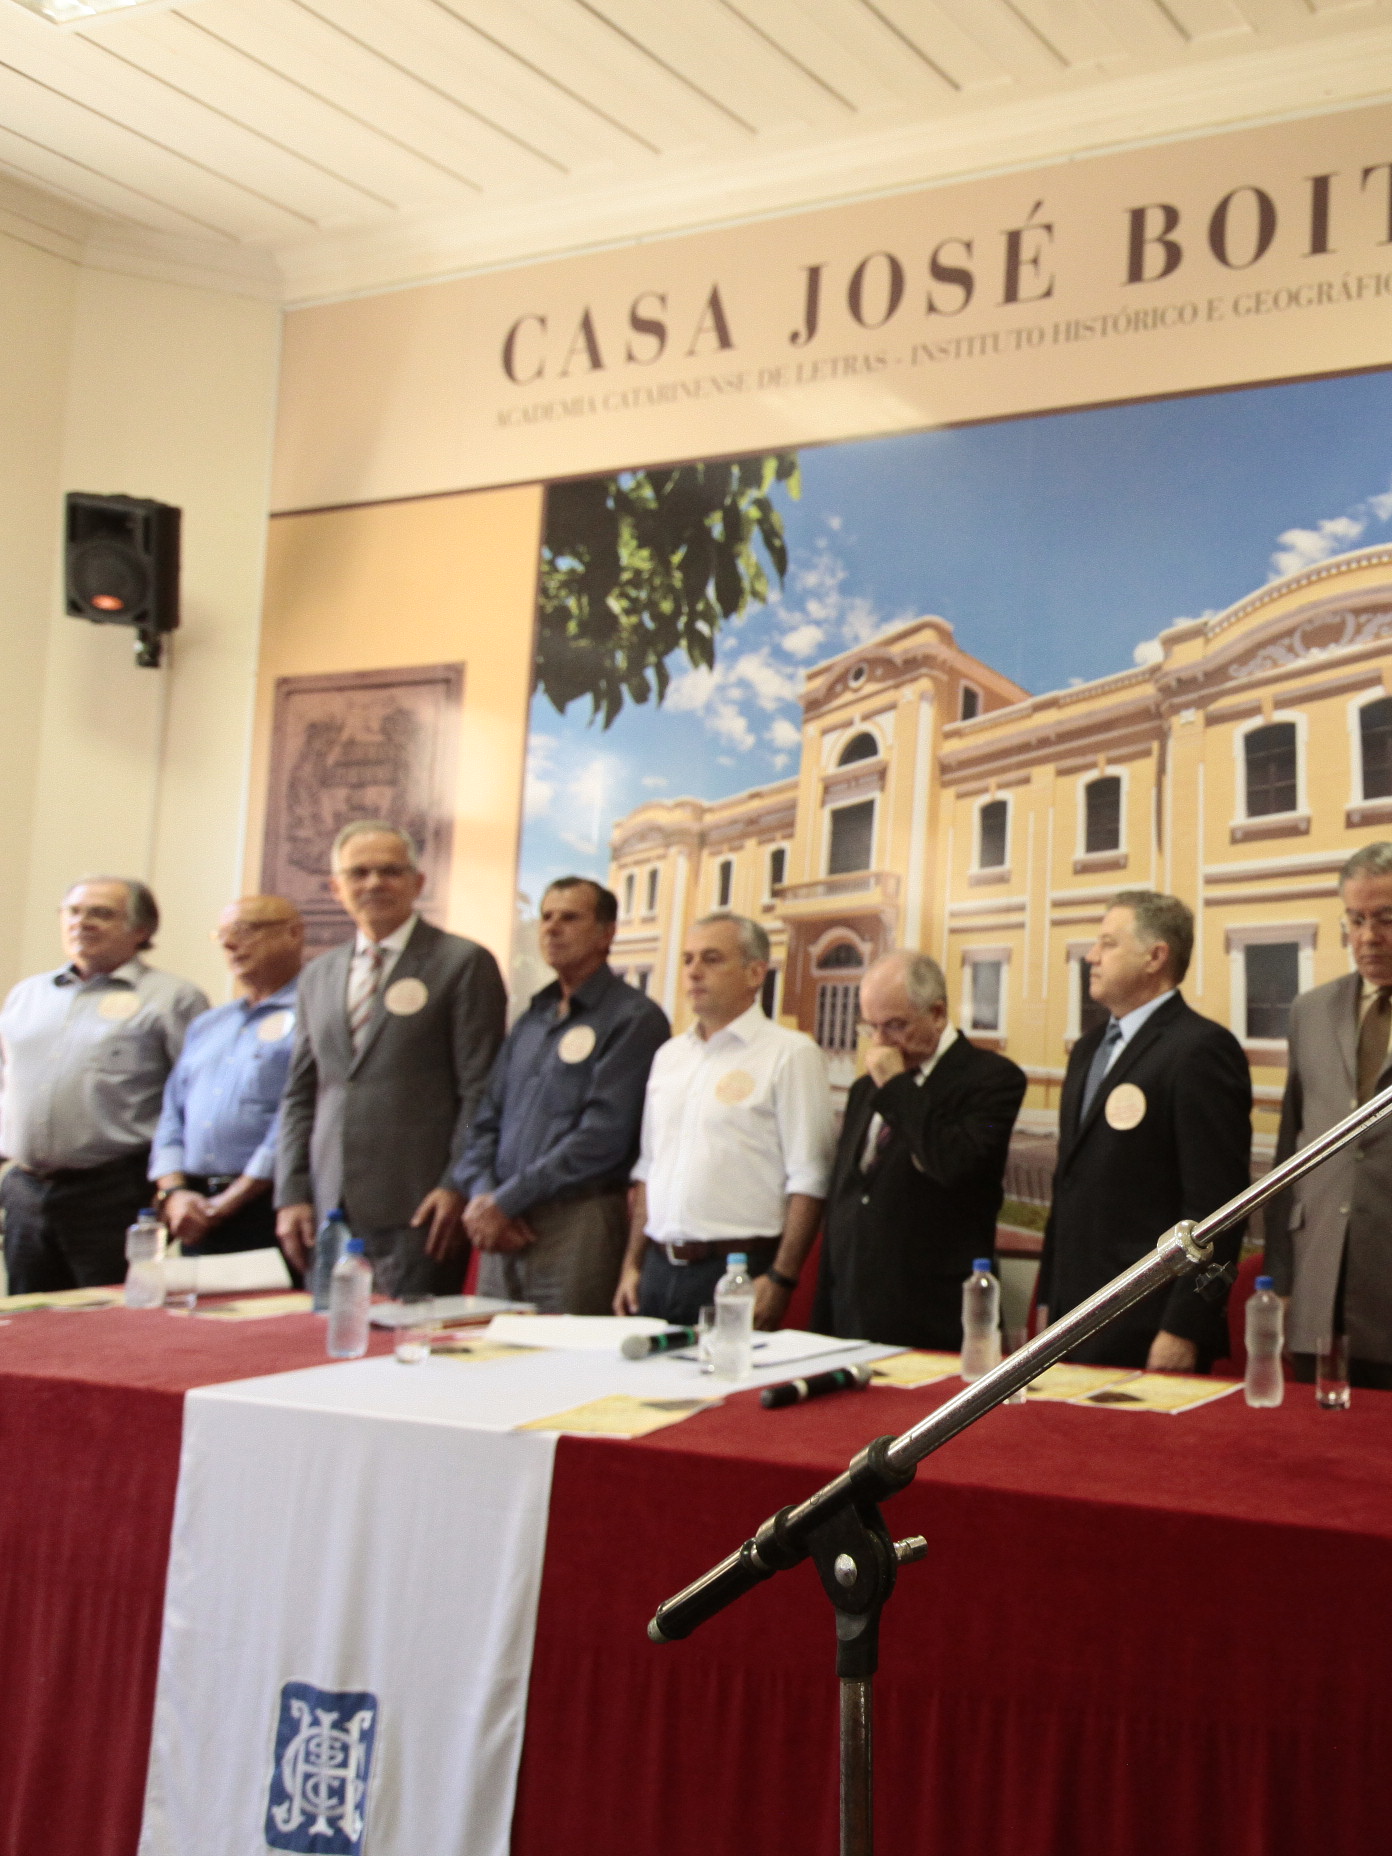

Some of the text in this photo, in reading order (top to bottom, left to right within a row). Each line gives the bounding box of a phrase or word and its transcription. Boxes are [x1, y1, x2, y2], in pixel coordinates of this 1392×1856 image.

[496, 395, 597, 428] ACADEMIA
[602, 373, 748, 411] CATARINENSE
[757, 364, 791, 390] DE
[795, 350, 888, 386] LETRAS
[909, 324, 1046, 369] INSTITUTO
[1052, 300, 1199, 345] HISTÓRICO
[1205, 296, 1226, 323] E
[501, 281, 736, 386] CASA
[789, 200, 1055, 347] JOSÉ
